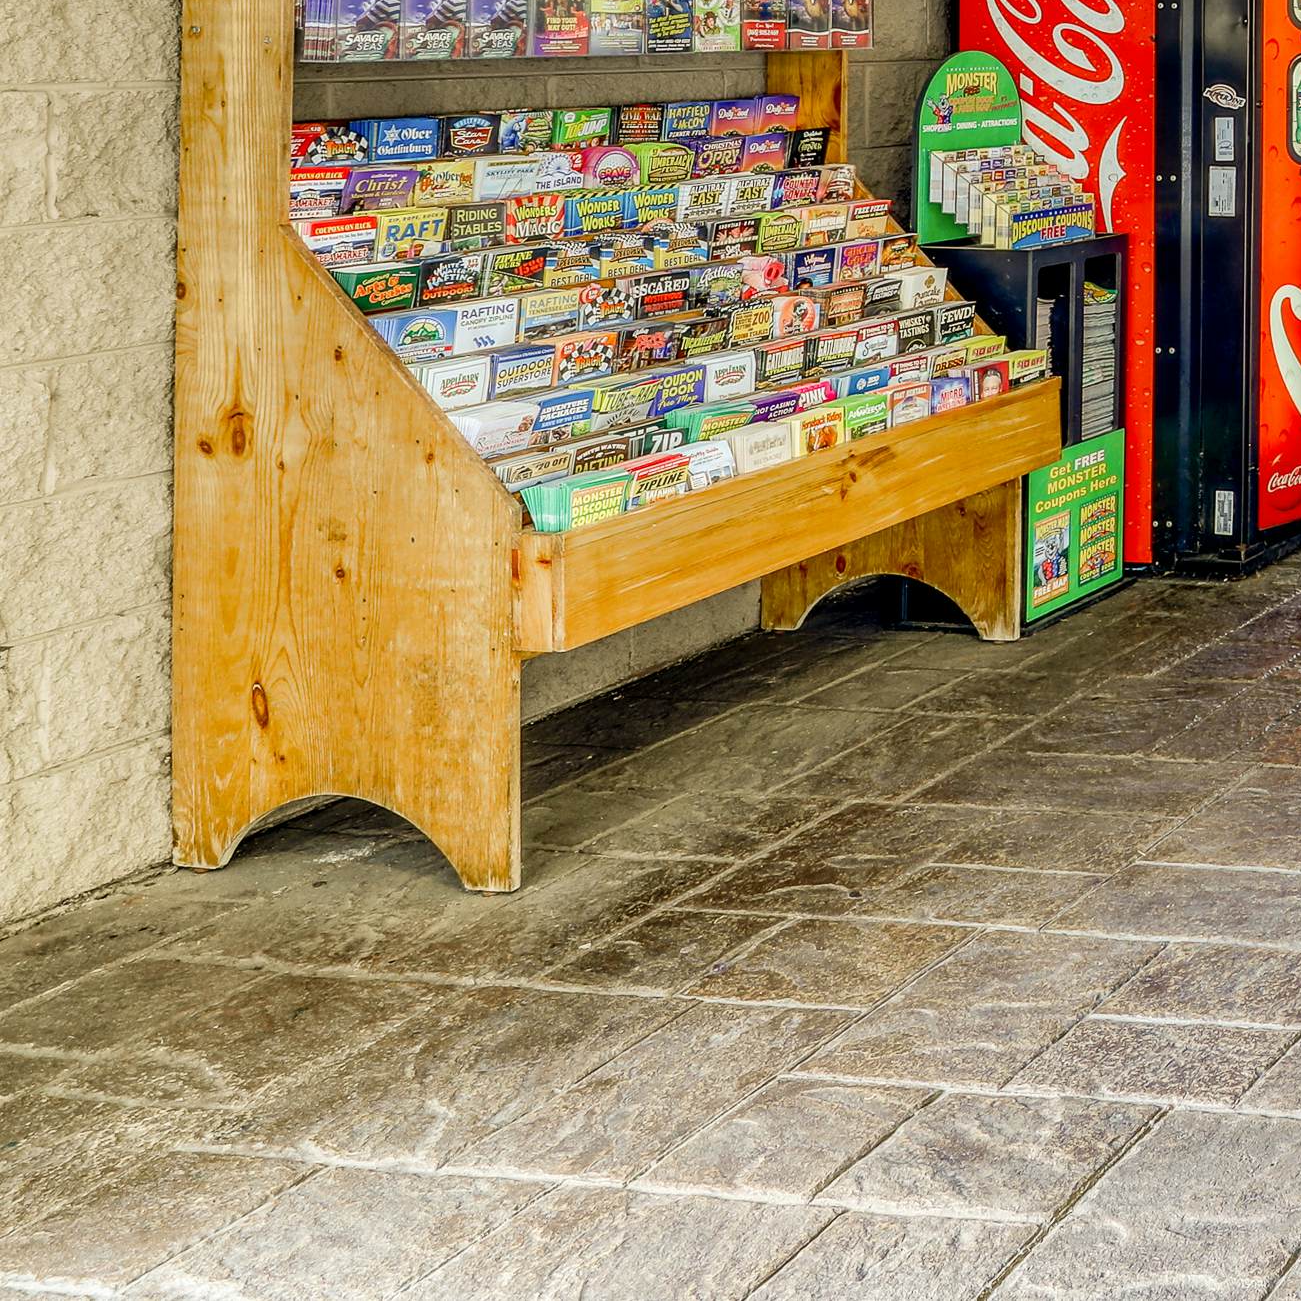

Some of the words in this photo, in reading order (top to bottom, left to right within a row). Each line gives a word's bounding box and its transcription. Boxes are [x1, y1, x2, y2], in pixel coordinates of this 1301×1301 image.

[345, 33, 385, 46] SAVAGE
[416, 32, 451, 44] SAVAGE
[427, 40, 450, 49] SEAS
[482, 32, 515, 43] SAVAGE
[492, 39, 513, 49] SEAS
[357, 41, 383, 51] SEAS
[946, 72, 997, 98] MONSTER
[669, 105, 710, 118] HATFIELD
[956, 121, 977, 130] DINING
[981, 118, 1018, 128] ATTRACTIONS
[400, 128, 432, 139] Ober
[457, 130, 487, 138] Star
[377, 144, 433, 156] Gatlinburg
[703, 139, 742, 150] CHRISTMAS
[699, 150, 740, 166] OPRY
[355, 176, 409, 194] Christ
[536, 180, 551, 190] THE
[553, 176, 582, 188] ISLAND
[690, 182, 725, 193] ALCATRAZ
[736, 177, 771, 188] ALCATRAZ
[690, 191, 722, 206] EAST
[736, 186, 766, 200] EAST
[577, 200, 620, 217] WONDER
[634, 193, 675, 209] WONDER
[457, 209, 497, 223] RIDING
[516, 206, 557, 221] WONDERS
[638, 208, 669, 222] WORKS
[386, 219, 444, 241] RAFT
[453, 222, 502, 236] STABLES
[516, 221, 562, 238] MAGIC
[582, 216, 616, 231] WORKS
[1013, 216, 1054, 243] DISCOUNT
[1055, 210, 1093, 230] COUPONS
[1040, 225, 1066, 240] FREE
[496, 251, 533, 263] ZIPLINE
[664, 257, 683, 267] BEST
[684, 254, 701, 264] DEAL
[494, 260, 521, 270] TOURS
[607, 267, 627, 277] BEST
[629, 265, 647, 274] DEAL
[354, 279, 386, 298] Arts
[427, 273, 475, 290] RAFTING
[551, 277, 570, 287] BEST
[640, 278, 690, 296] SCARED
[369, 283, 413, 304] Crafts
[422, 286, 474, 300] OUTDOORS
[529, 294, 578, 308] RAFTING
[461, 303, 515, 319] RAFTING
[752, 311, 770, 325] ZOO
[940, 305, 976, 324] FEWD!
[461, 316, 486, 327] CANOPY
[900, 314, 926, 329] WHISKEY
[900, 325, 930, 339] TASTINGS
[498, 357, 552, 378] OUTDOOR
[935, 357, 964, 372] DRESS
[497, 369, 551, 389] SUPERSTORE
[662, 383, 696, 397] BOOK
[941, 389, 964, 400] MICRO
[768, 407, 795, 419] ACTION
[771, 400, 796, 412] CASINO
[540, 406, 588, 422] PACKAGES
[702, 416, 747, 432] MONSTER
[652, 431, 684, 454] ZIP
[552, 456, 568, 467] OFF
[1050, 461, 1072, 479] Get
[1074, 449, 1105, 470] FREE
[636, 470, 685, 495] ZIPLINE
[1047, 463, 1107, 495] MONSTER
[572, 486, 623, 506] MONSTER
[1035, 485, 1087, 513] Coupons
[1090, 474, 1118, 492] Here
[572, 496, 622, 517] DISCOUNT
[1080, 495, 1116, 522] MONSTER
[571, 507, 620, 528] COUPONS
[1080, 517, 1116, 546] MONSTER
[1080, 536, 1115, 570] MONSTER
